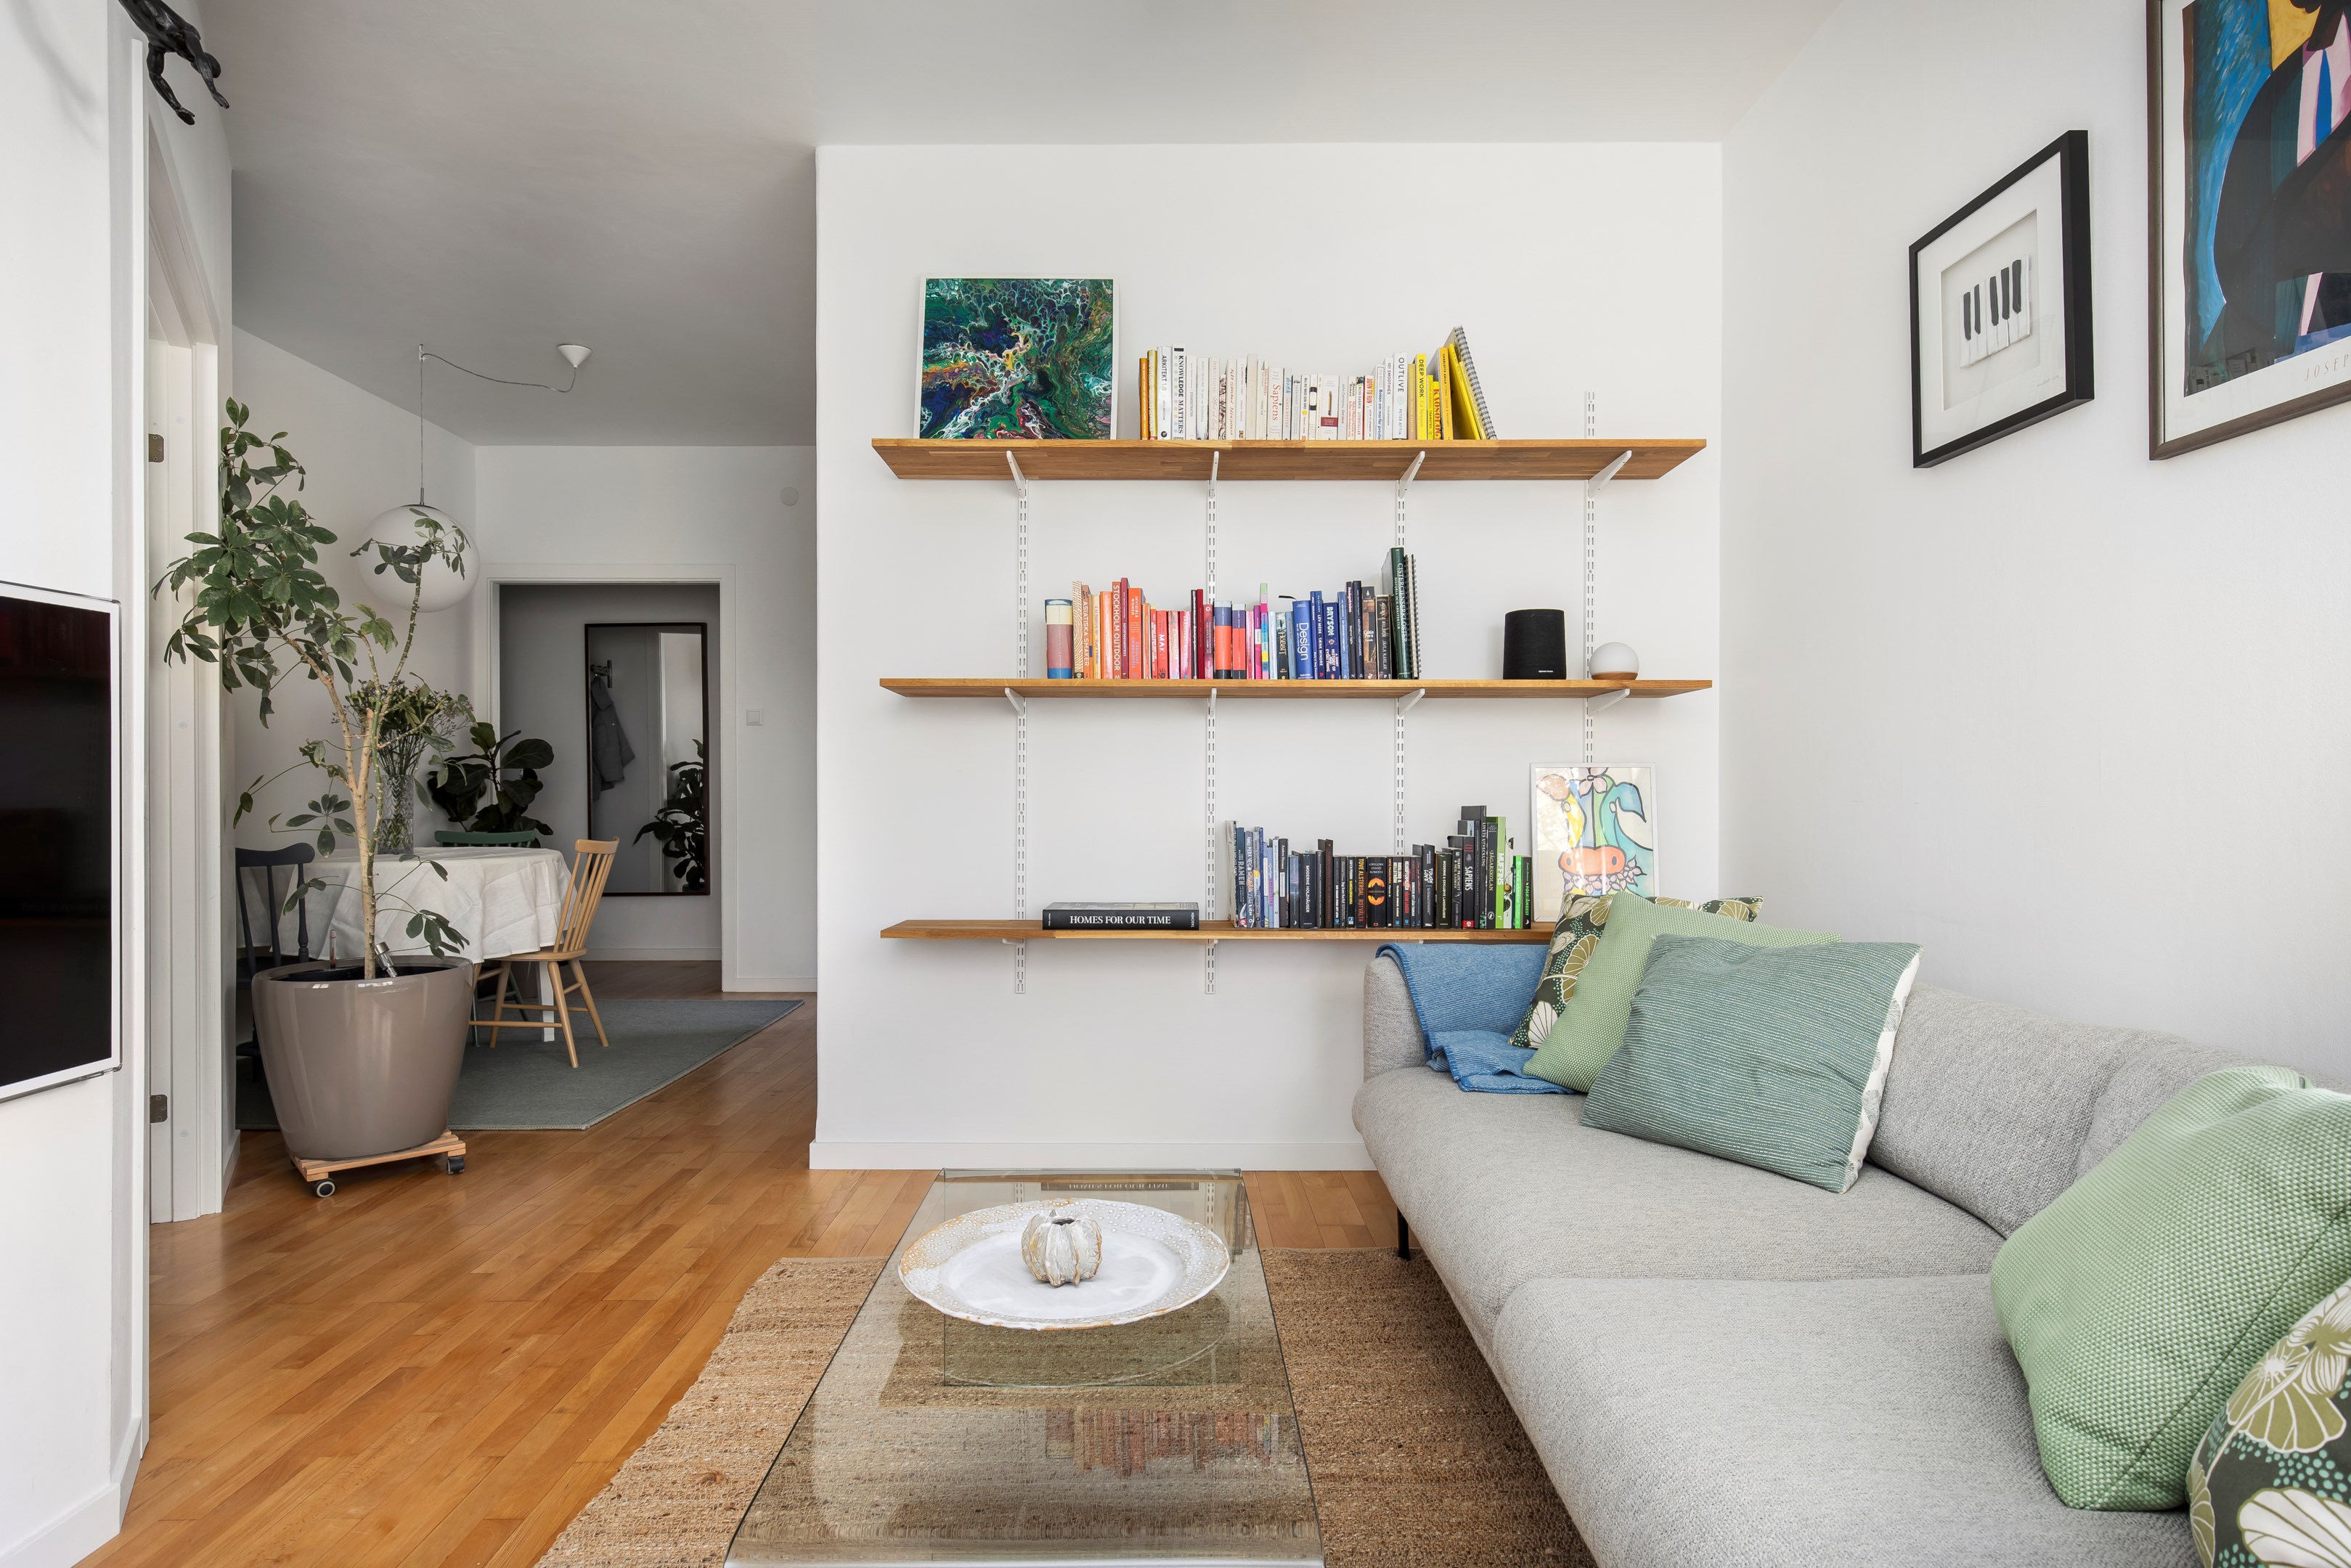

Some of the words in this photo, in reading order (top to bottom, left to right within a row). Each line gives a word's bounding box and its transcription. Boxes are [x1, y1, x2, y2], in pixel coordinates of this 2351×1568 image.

[2305, 354, 2349, 381] JOSEP
[1270, 385, 1282, 421] Sapiens
[1398, 563, 1408, 642] CISTERCIENSERKLOSTER
[1278, 632, 1287, 656] HOBBIT
[1297, 622, 1310, 661] Design
[1464, 866, 1473, 891] SAPIENS
[1070, 915, 1104, 924] HOMES
[1105, 915, 1124, 924] FOR
[1125, 915, 1146, 924] OUR
[1146, 915, 1171, 924] TIME
